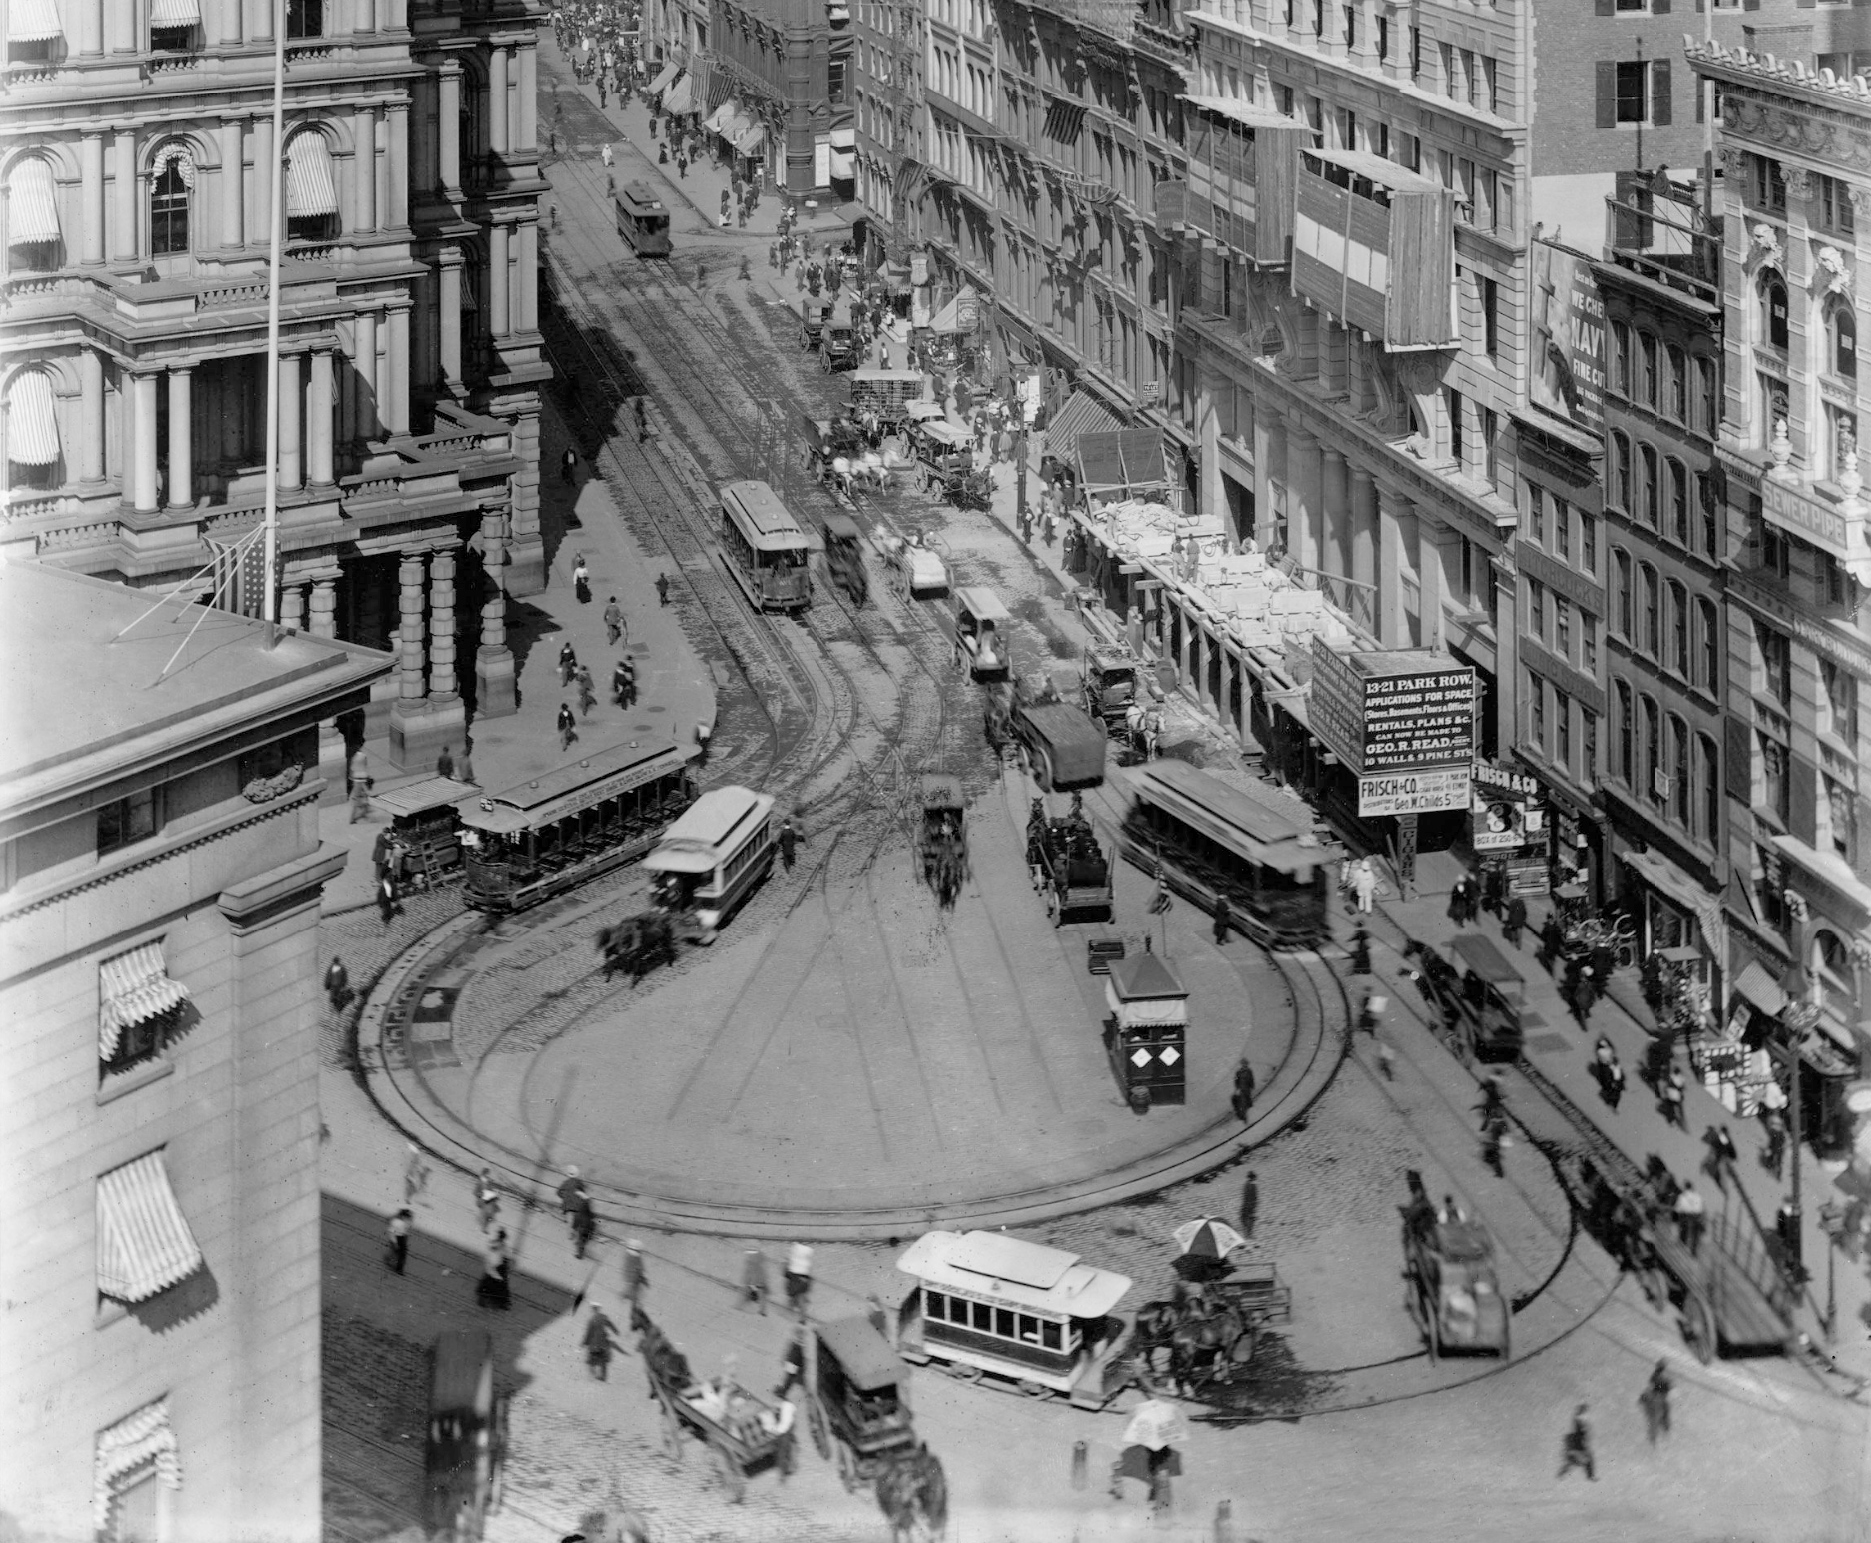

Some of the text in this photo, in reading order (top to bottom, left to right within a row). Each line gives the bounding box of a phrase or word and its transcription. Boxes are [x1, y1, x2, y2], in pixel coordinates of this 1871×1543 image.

[1571, 289, 1604, 319] WE CHE
[1573, 357, 1591, 383] FINE
[1764, 482, 1843, 543] SEWER PIPE
[1366, 674, 1472, 694] 13-21 PARK ROW.
[1365, 693, 1422, 707] APPLICATIONS
[1425, 691, 1443, 702] FOR
[1368, 719, 1416, 732] RENTALS,
[1417, 717, 1452, 728] PLANS
[1375, 733, 1392, 741] CAN
[1395, 731, 1412, 739] NOW
[1427, 728, 1450, 736] MADE
[1365, 742, 1397, 754] GEO.
[1398, 741, 1410, 752] R.
[1364, 758, 1375, 766] 10
[1377, 755, 1407, 765] WALL
[1408, 754, 1414, 762] &
[1417, 752, 1424, 761] 9
[1426, 750, 1452, 760] PINE
[1471, 763, 1510, 788] FRISCH
[1511, 774, 1522, 791] &
[1362, 779, 1398, 798] FRISCH
[1405, 777, 1419, 794] CO.
